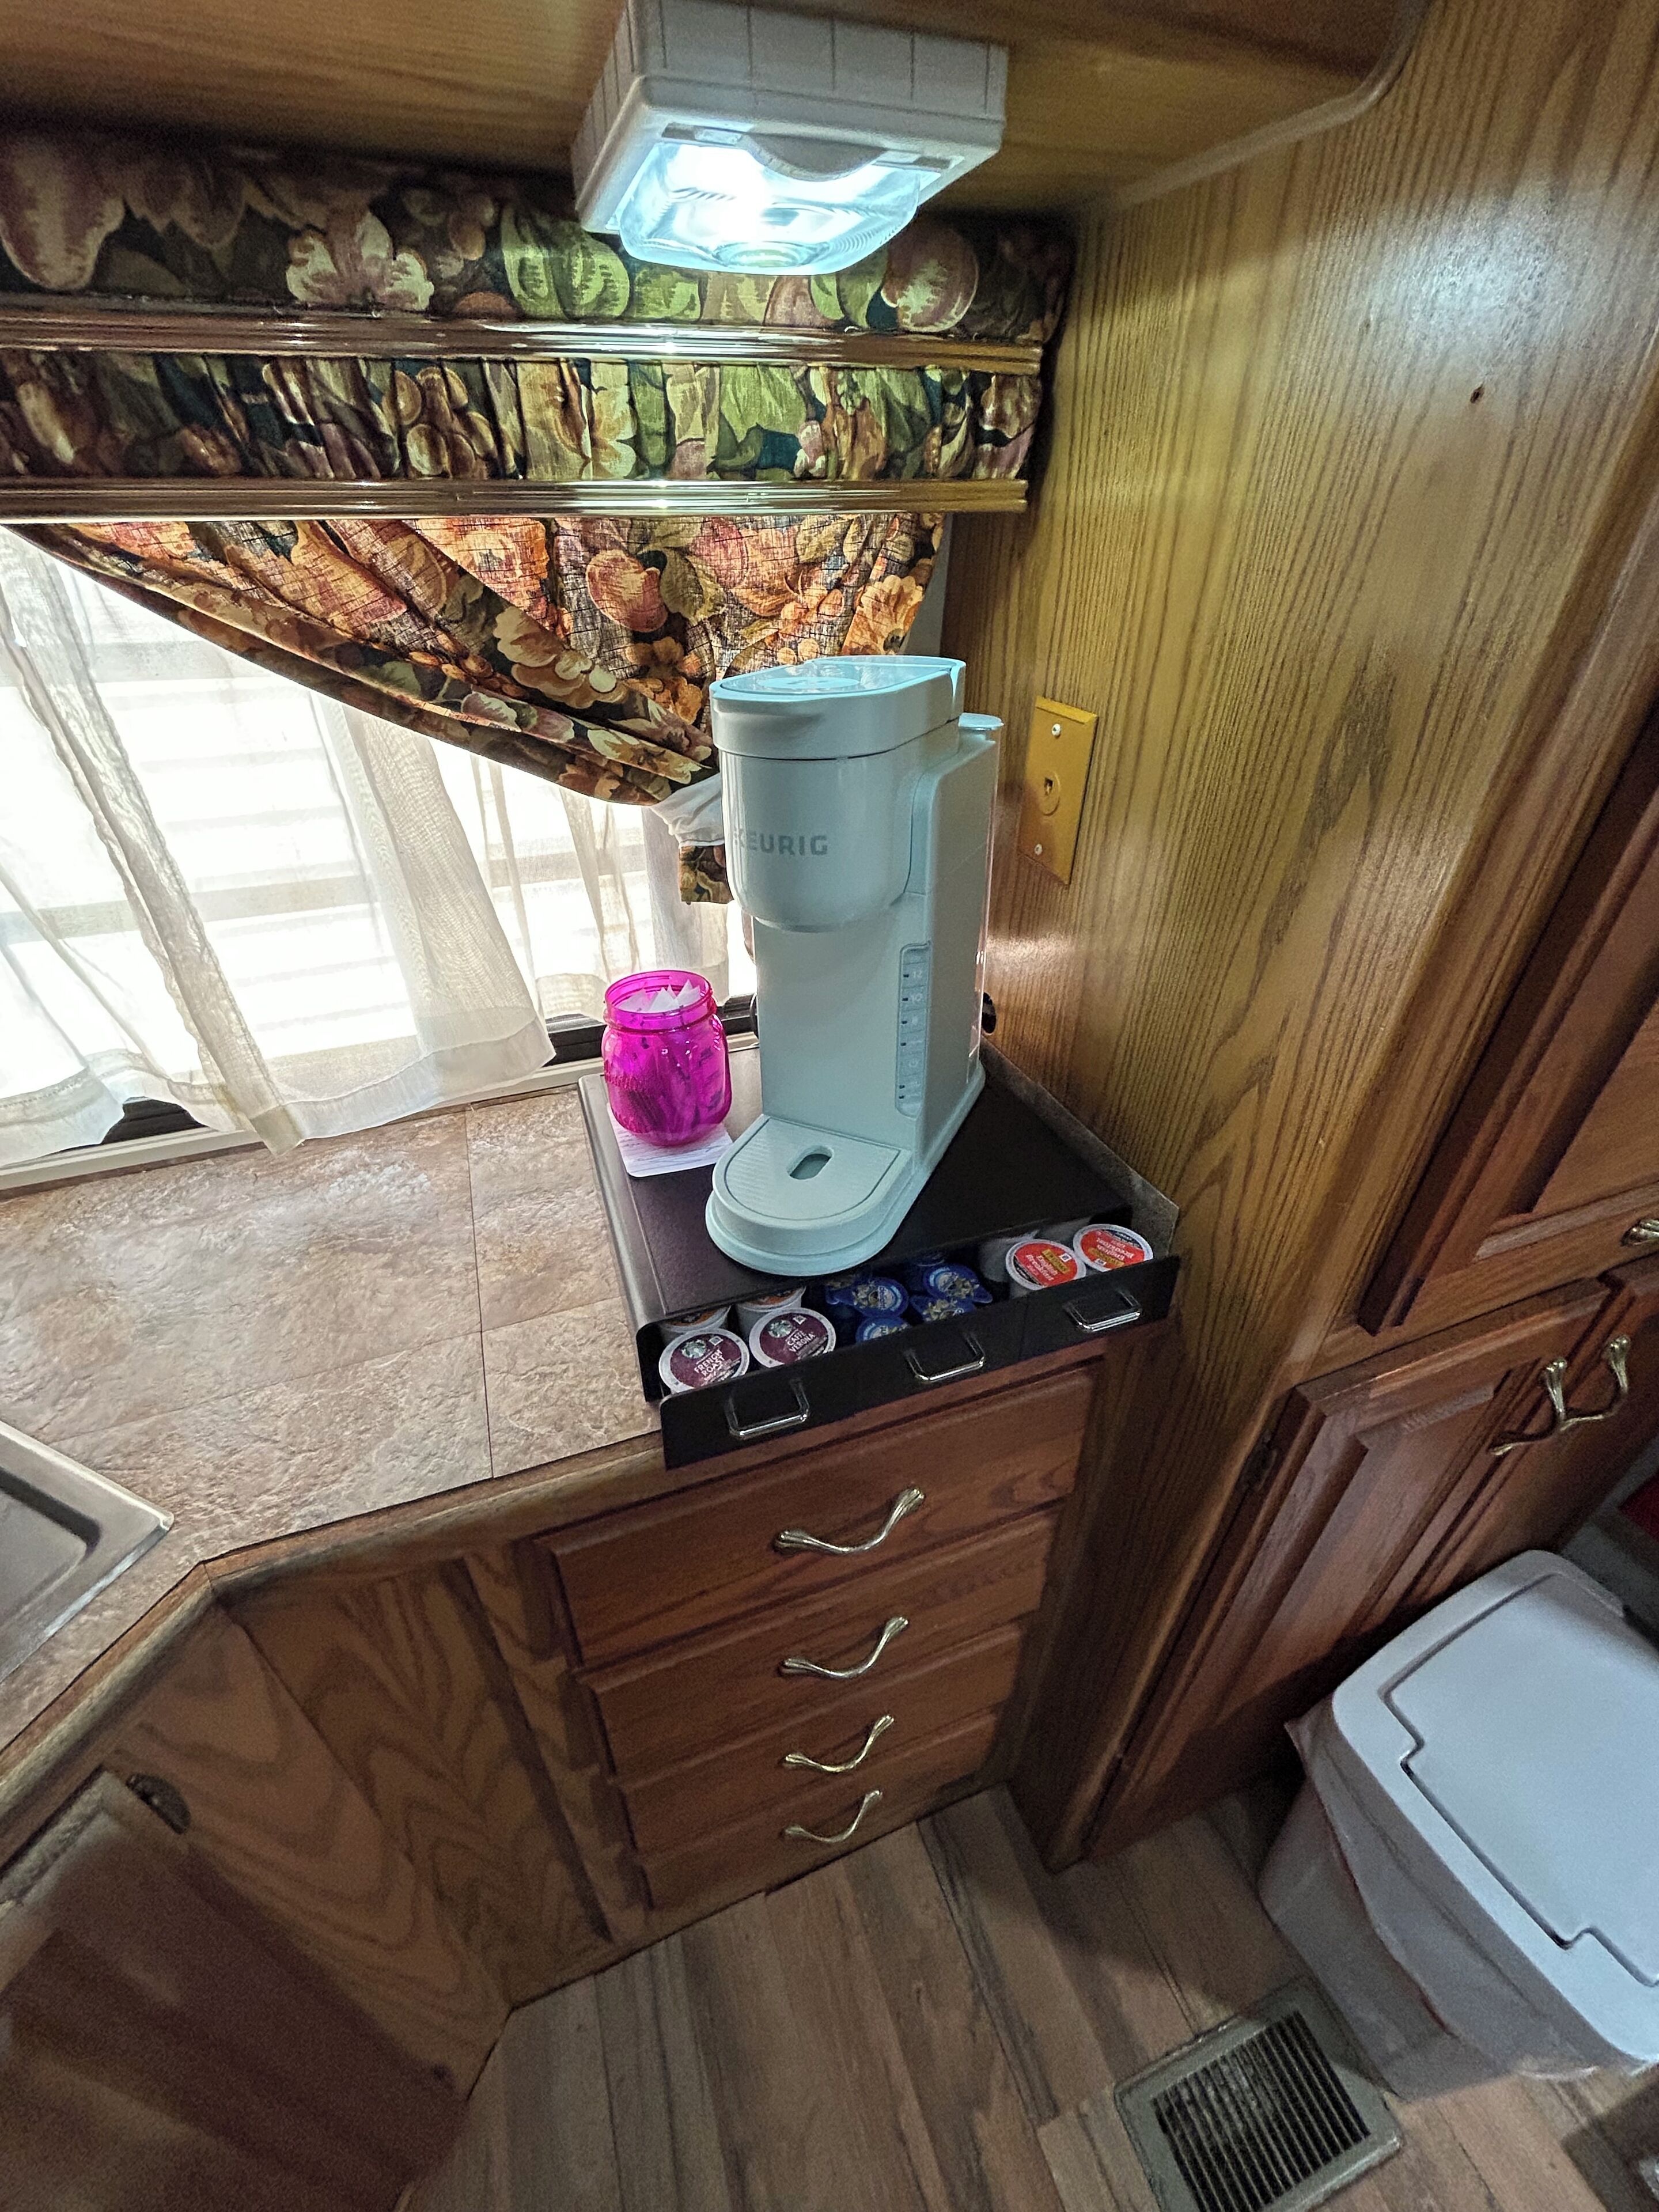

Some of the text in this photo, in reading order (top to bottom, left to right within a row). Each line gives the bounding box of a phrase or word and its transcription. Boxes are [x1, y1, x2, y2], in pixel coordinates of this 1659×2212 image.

[789, 1332, 816, 1352] VERONA
[694, 1349, 723, 1373] FRENCH
[701, 1355, 725, 1376] ROAST
